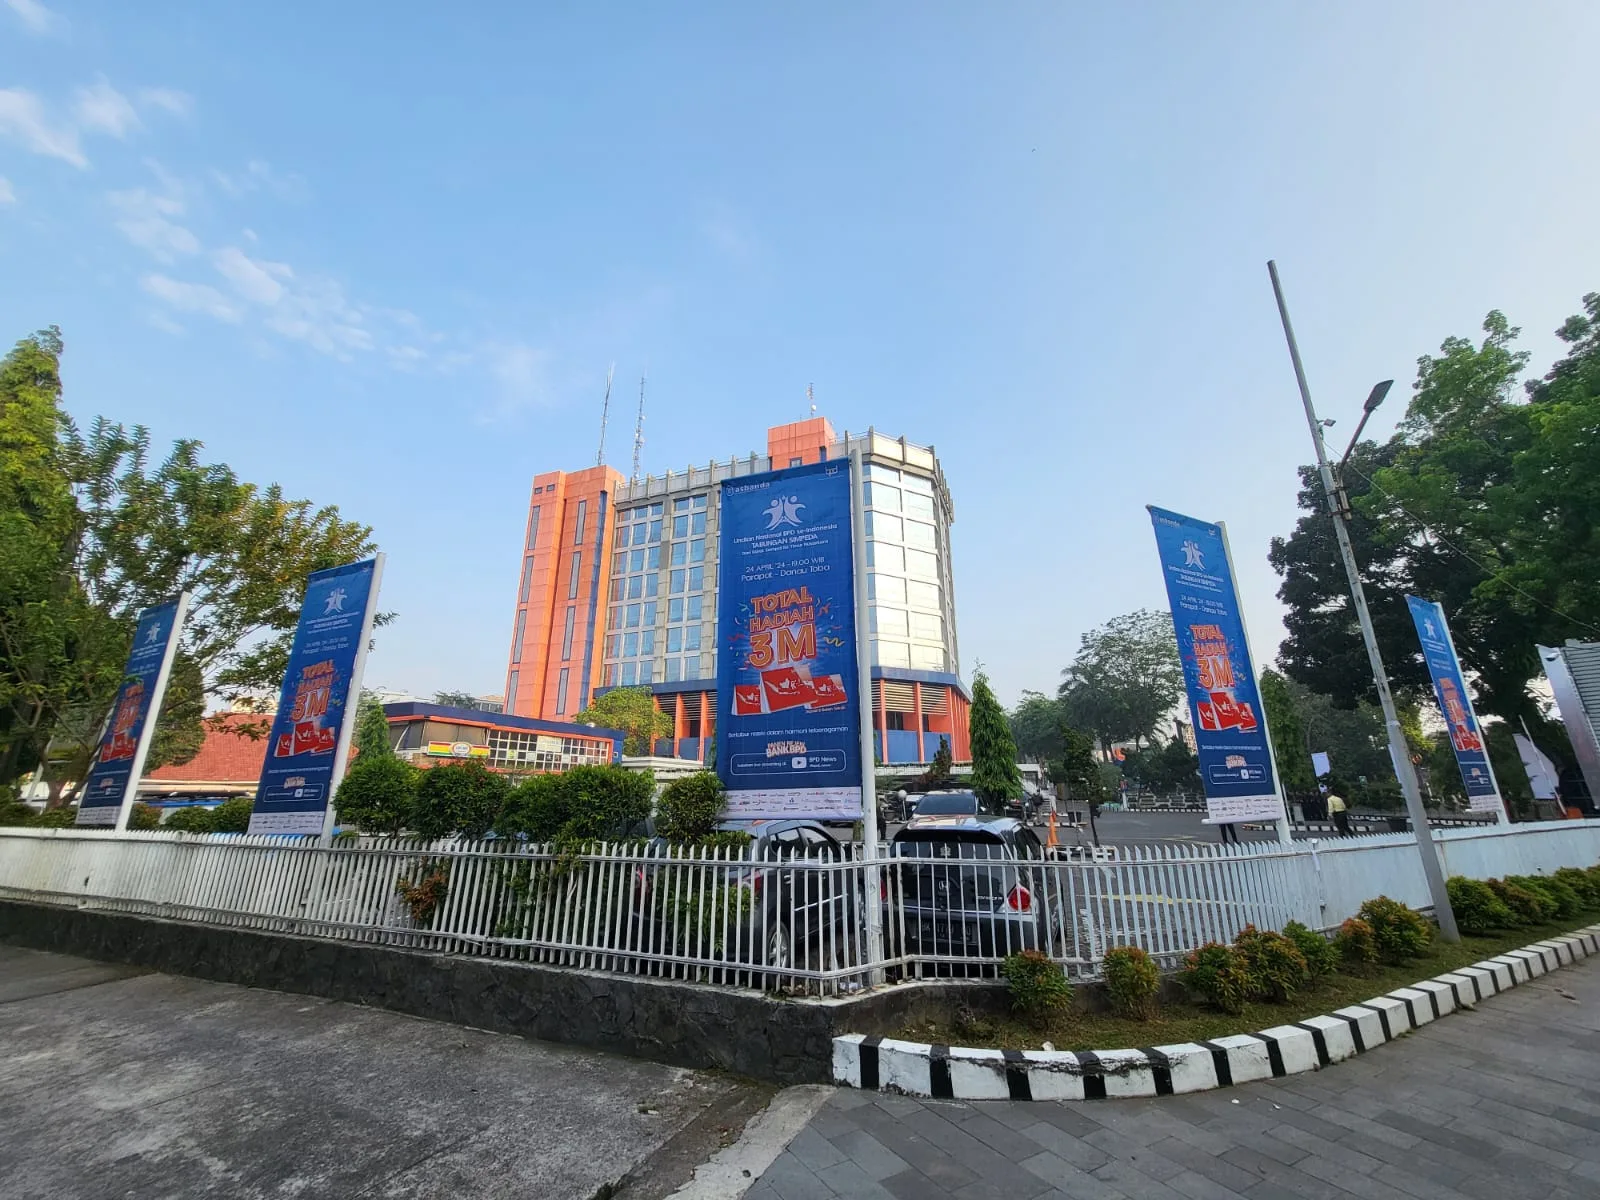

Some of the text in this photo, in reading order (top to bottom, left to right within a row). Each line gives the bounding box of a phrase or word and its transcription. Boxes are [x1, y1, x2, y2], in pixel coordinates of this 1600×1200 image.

[751, 538, 788, 549] TABUNGAN
[756, 563, 774, 572] APRIL
[811, 556, 825, 564] WIB
[741, 571, 773, 582] Parapat
[780, 567, 808, 577] Danau
[809, 564, 830, 573] Toba
[750, 586, 813, 614] TOTAL
[750, 605, 814, 633] HADIAH
[1189, 624, 1226, 640] TOTAL
[766, 744, 807, 758] BANK BPD
